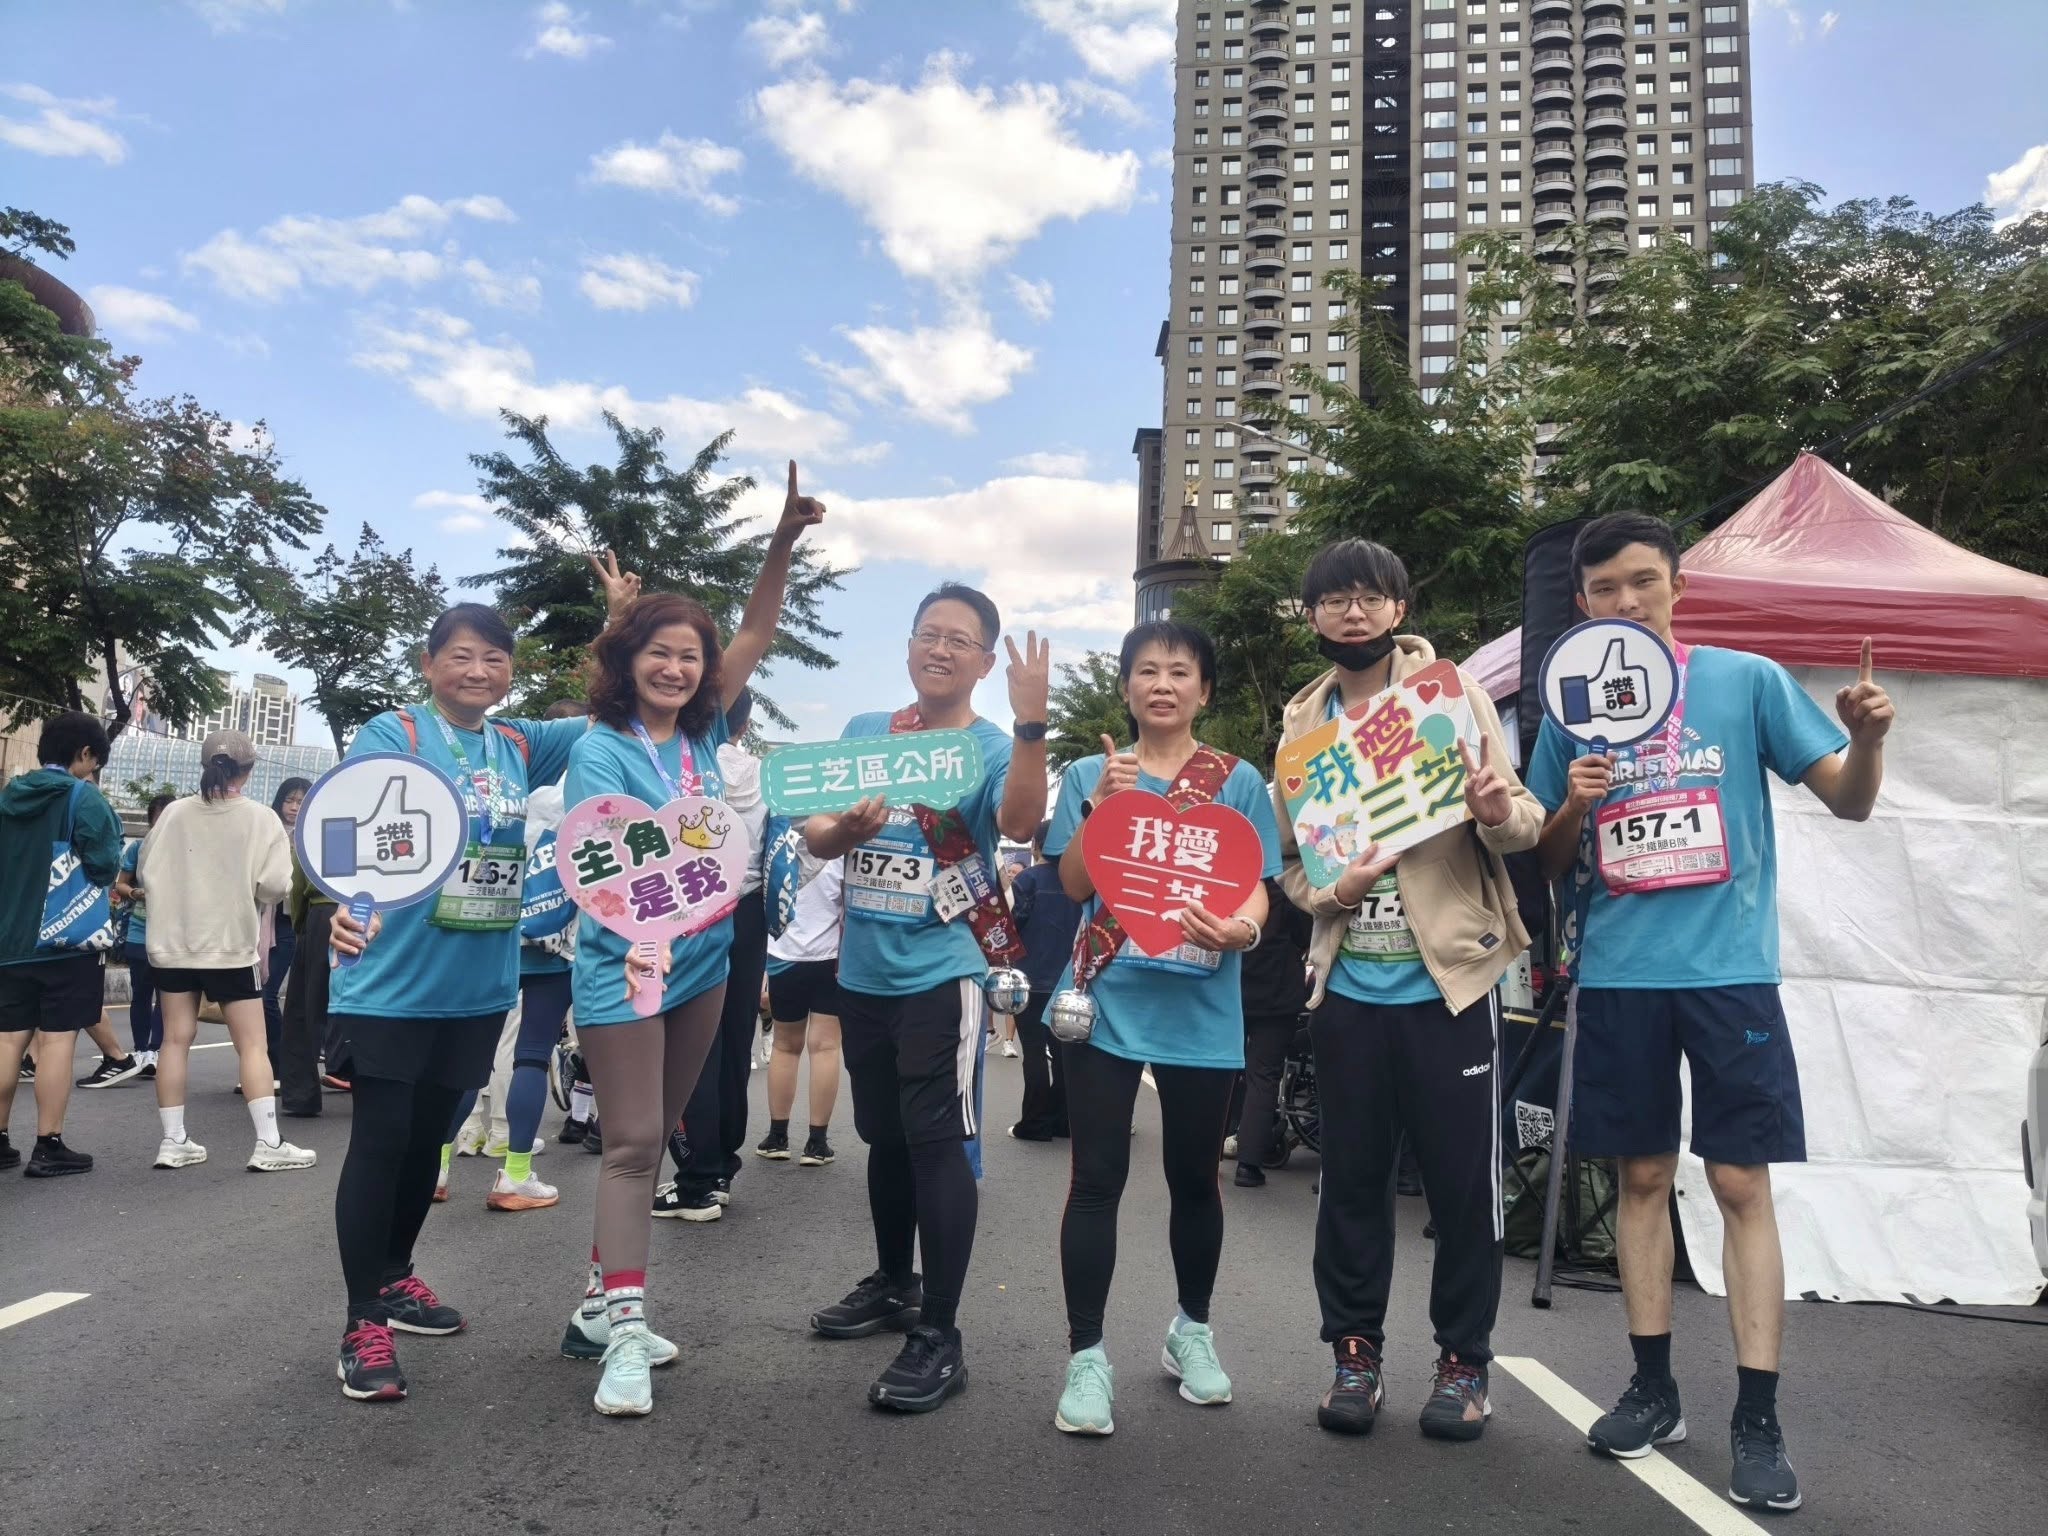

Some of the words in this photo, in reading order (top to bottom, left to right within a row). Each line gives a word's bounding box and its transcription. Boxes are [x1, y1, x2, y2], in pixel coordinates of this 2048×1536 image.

[1602, 675, 1637, 710] 讚
[783, 744, 964, 796] 三芝區公所
[1304, 693, 1426, 804] 我愛
[1361, 744, 1468, 843] 三芝
[374, 821, 416, 862] 讚
[1125, 815, 1220, 874] 我愛
[1610, 808, 1702, 847] 157-1
[458, 860, 519, 885] 16-2
[571, 820, 673, 886] 主角
[851, 850, 921, 881] 157-3
[629, 856, 728, 922] 是我
[947, 874, 969, 903] 157
